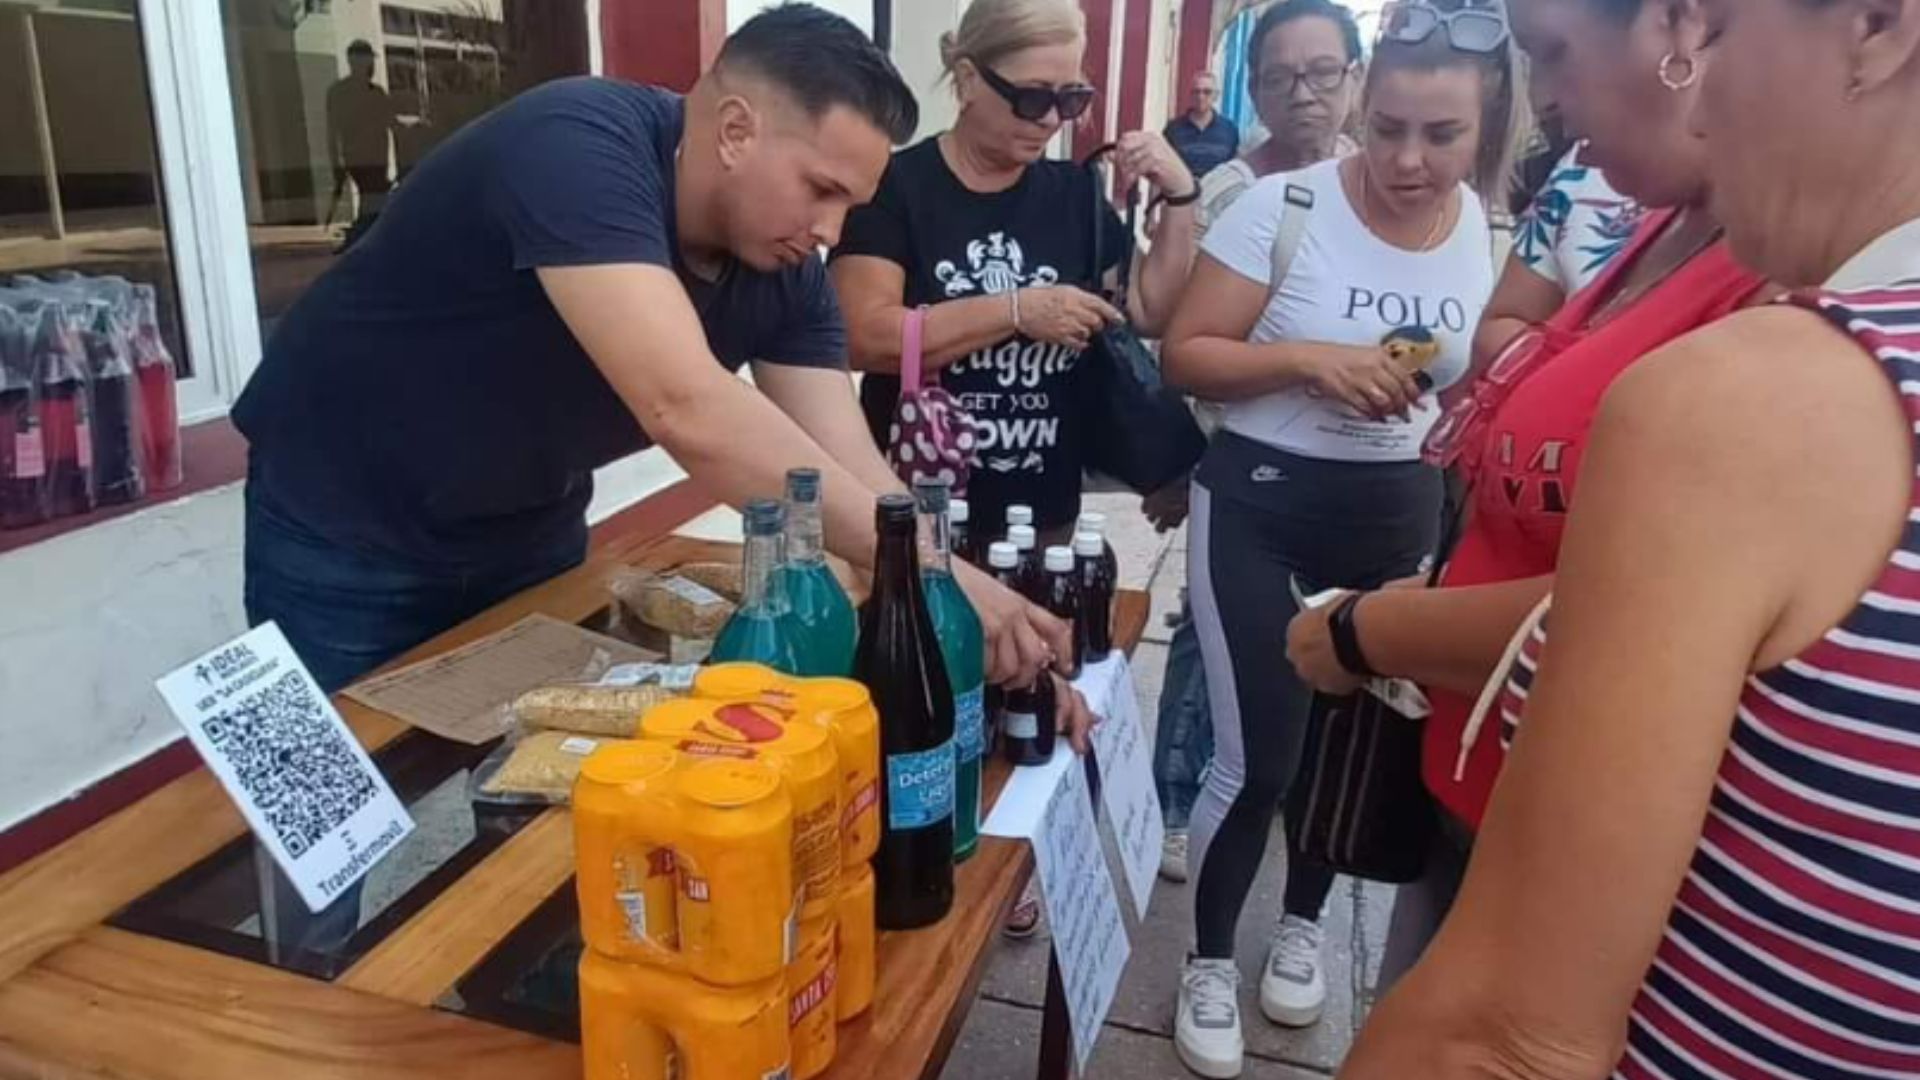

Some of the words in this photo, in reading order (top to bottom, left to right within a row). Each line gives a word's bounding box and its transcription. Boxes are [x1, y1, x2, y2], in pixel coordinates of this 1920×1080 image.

[1341, 286, 1466, 333] POLO
[949, 340, 1080, 387] uggle
[959, 392, 1002, 411] GET
[1008, 392, 1049, 413] YOU
[974, 416, 1058, 450] OWN
[209, 643, 255, 672] IDEAL
